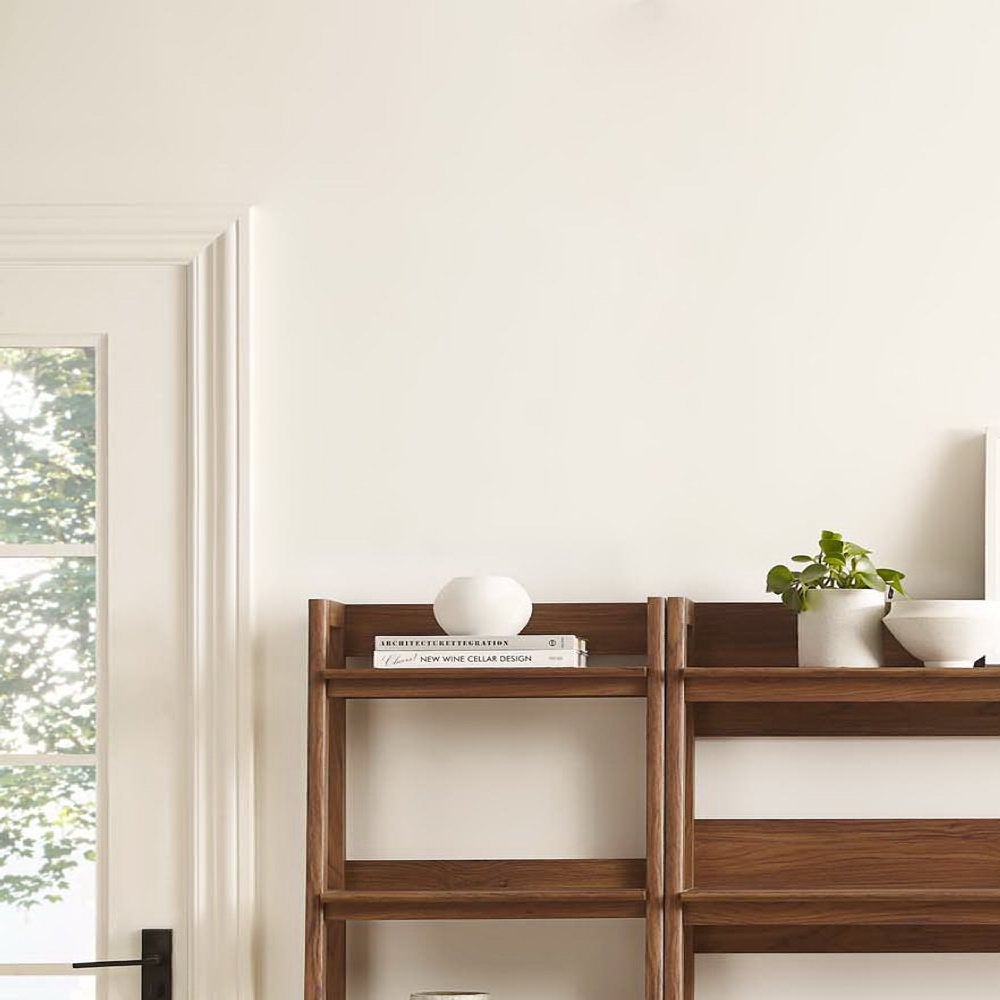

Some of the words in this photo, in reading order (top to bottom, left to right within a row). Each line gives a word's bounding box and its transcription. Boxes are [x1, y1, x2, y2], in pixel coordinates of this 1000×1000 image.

[420, 655, 440, 663] NEW
[442, 655, 465, 663] WINE
[467, 655, 498, 663] CELLAR
[499, 655, 532, 663] DESIGN
